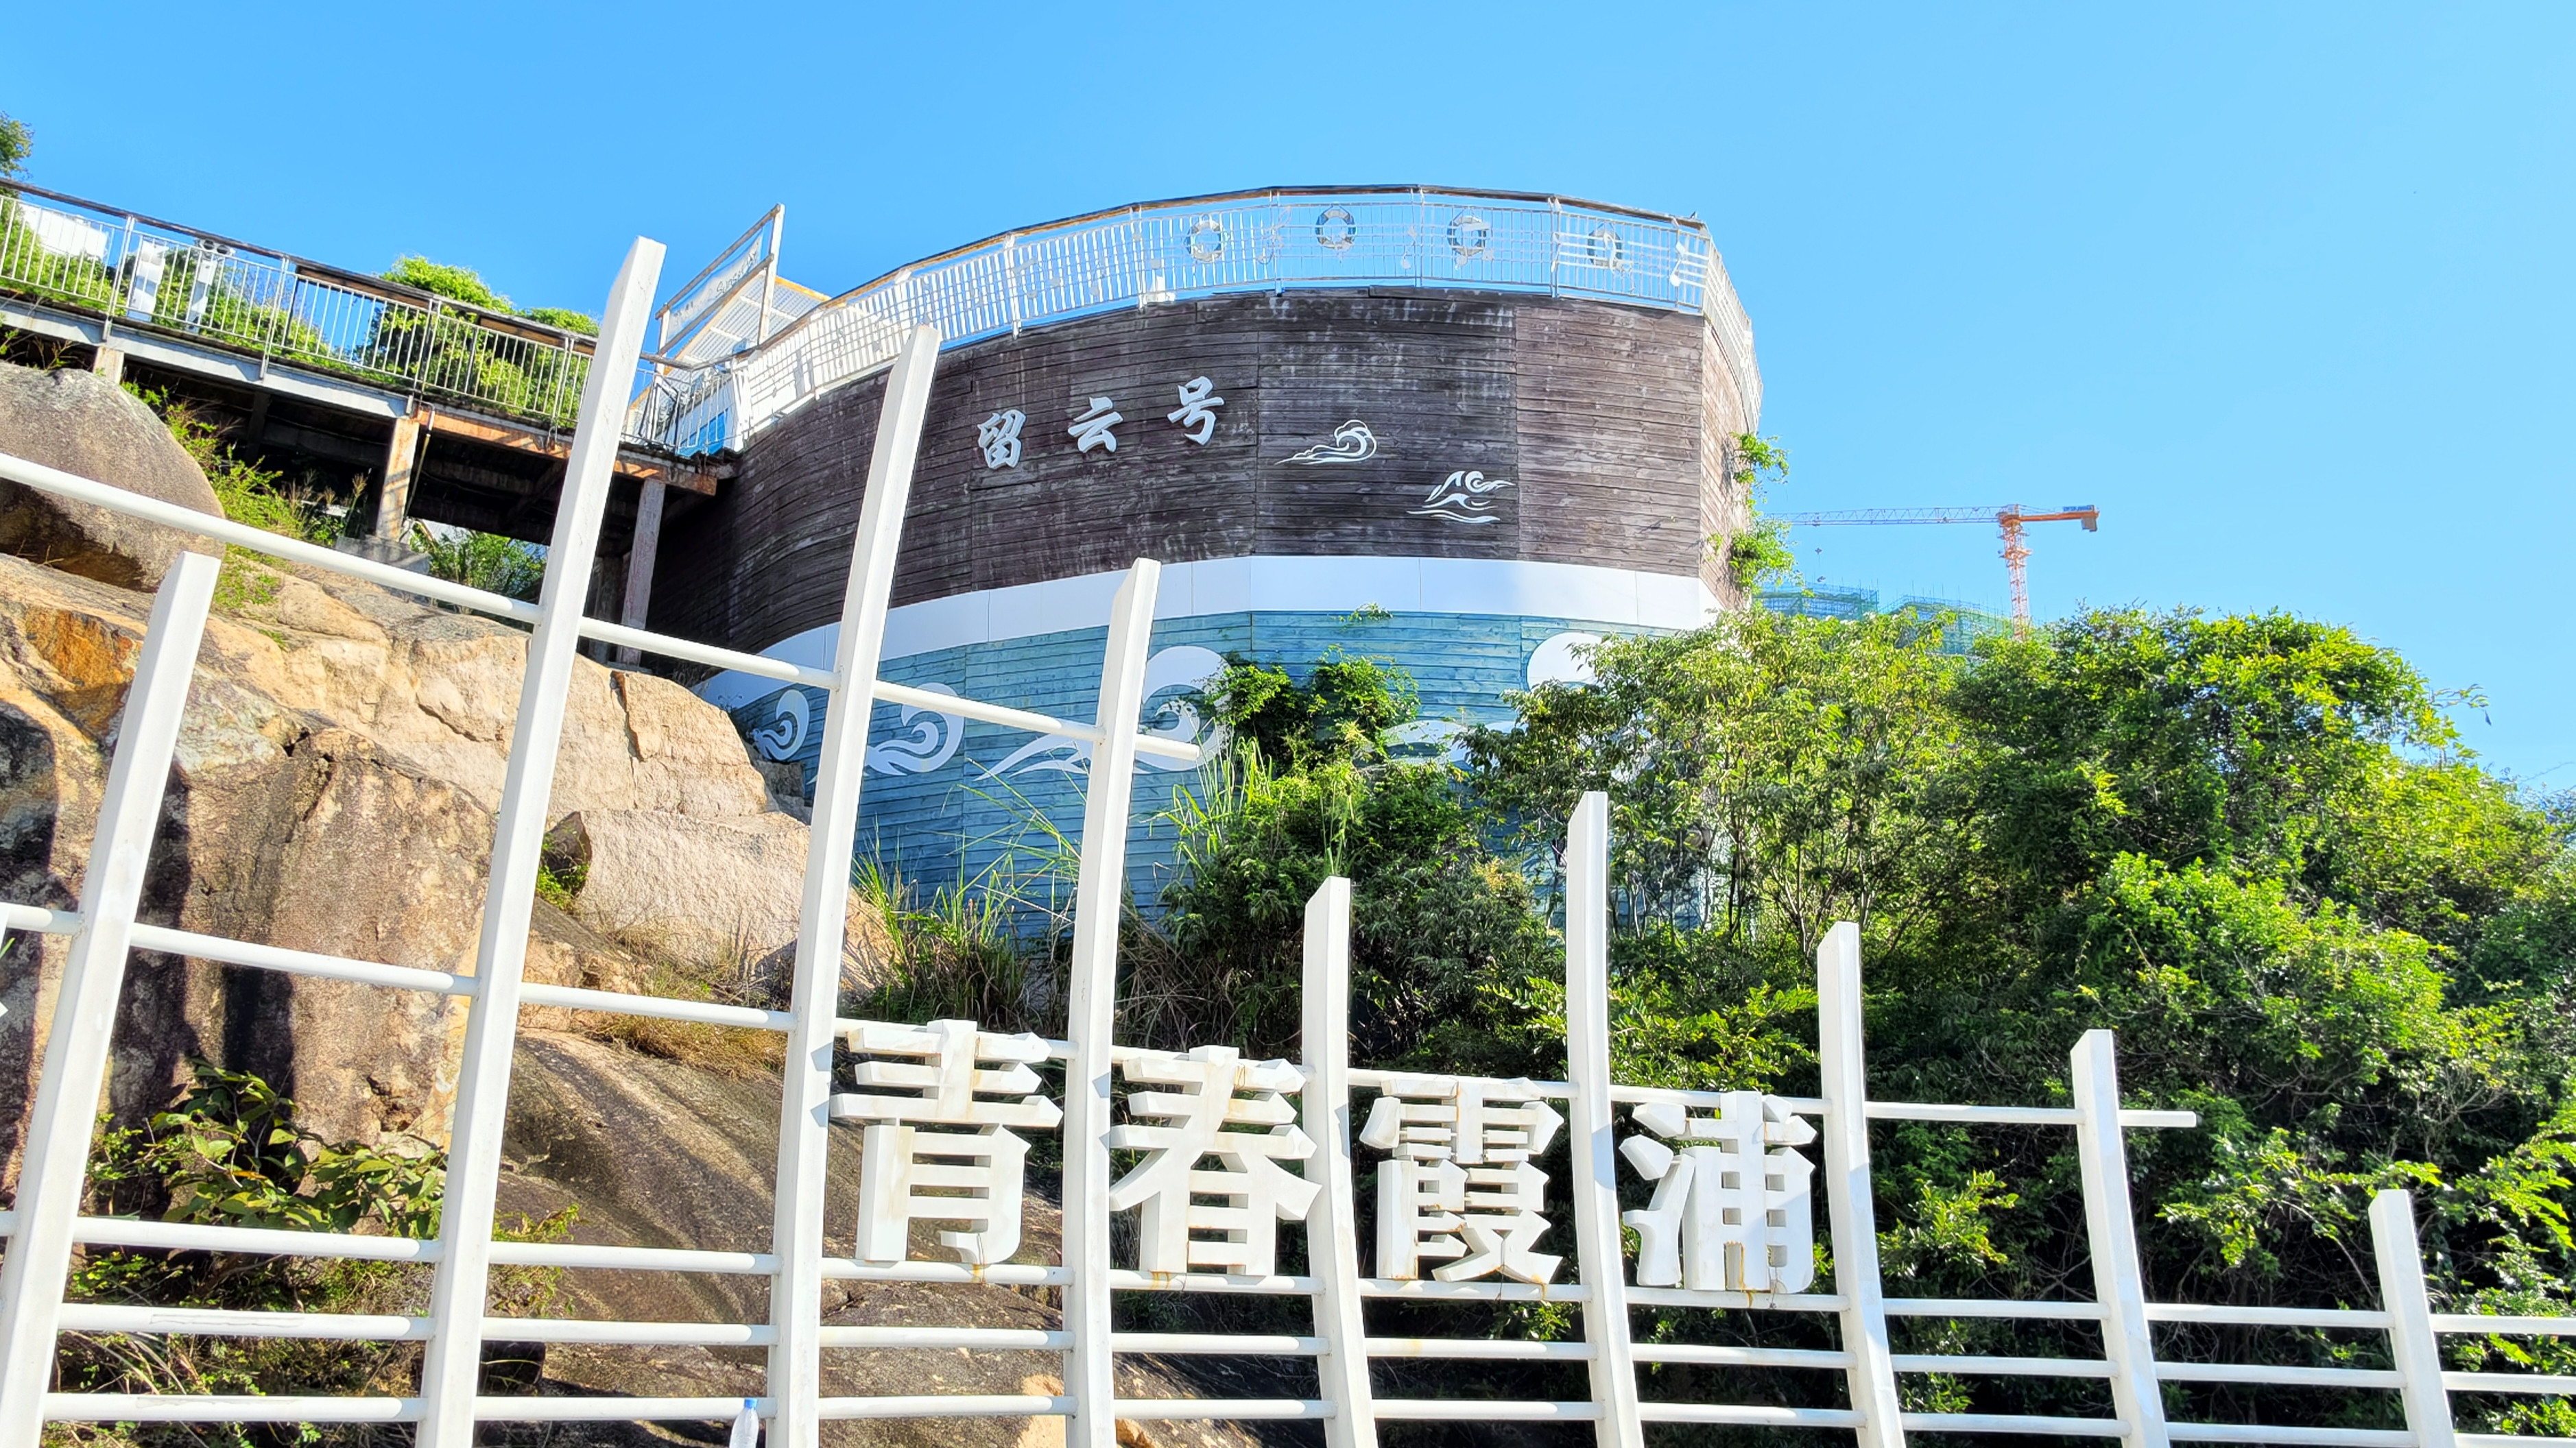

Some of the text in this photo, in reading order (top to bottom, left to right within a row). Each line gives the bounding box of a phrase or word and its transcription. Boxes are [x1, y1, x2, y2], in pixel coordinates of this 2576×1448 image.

[977, 376, 1224, 469] 留云号
[830, 1019, 1817, 1294] 青春霞浦
